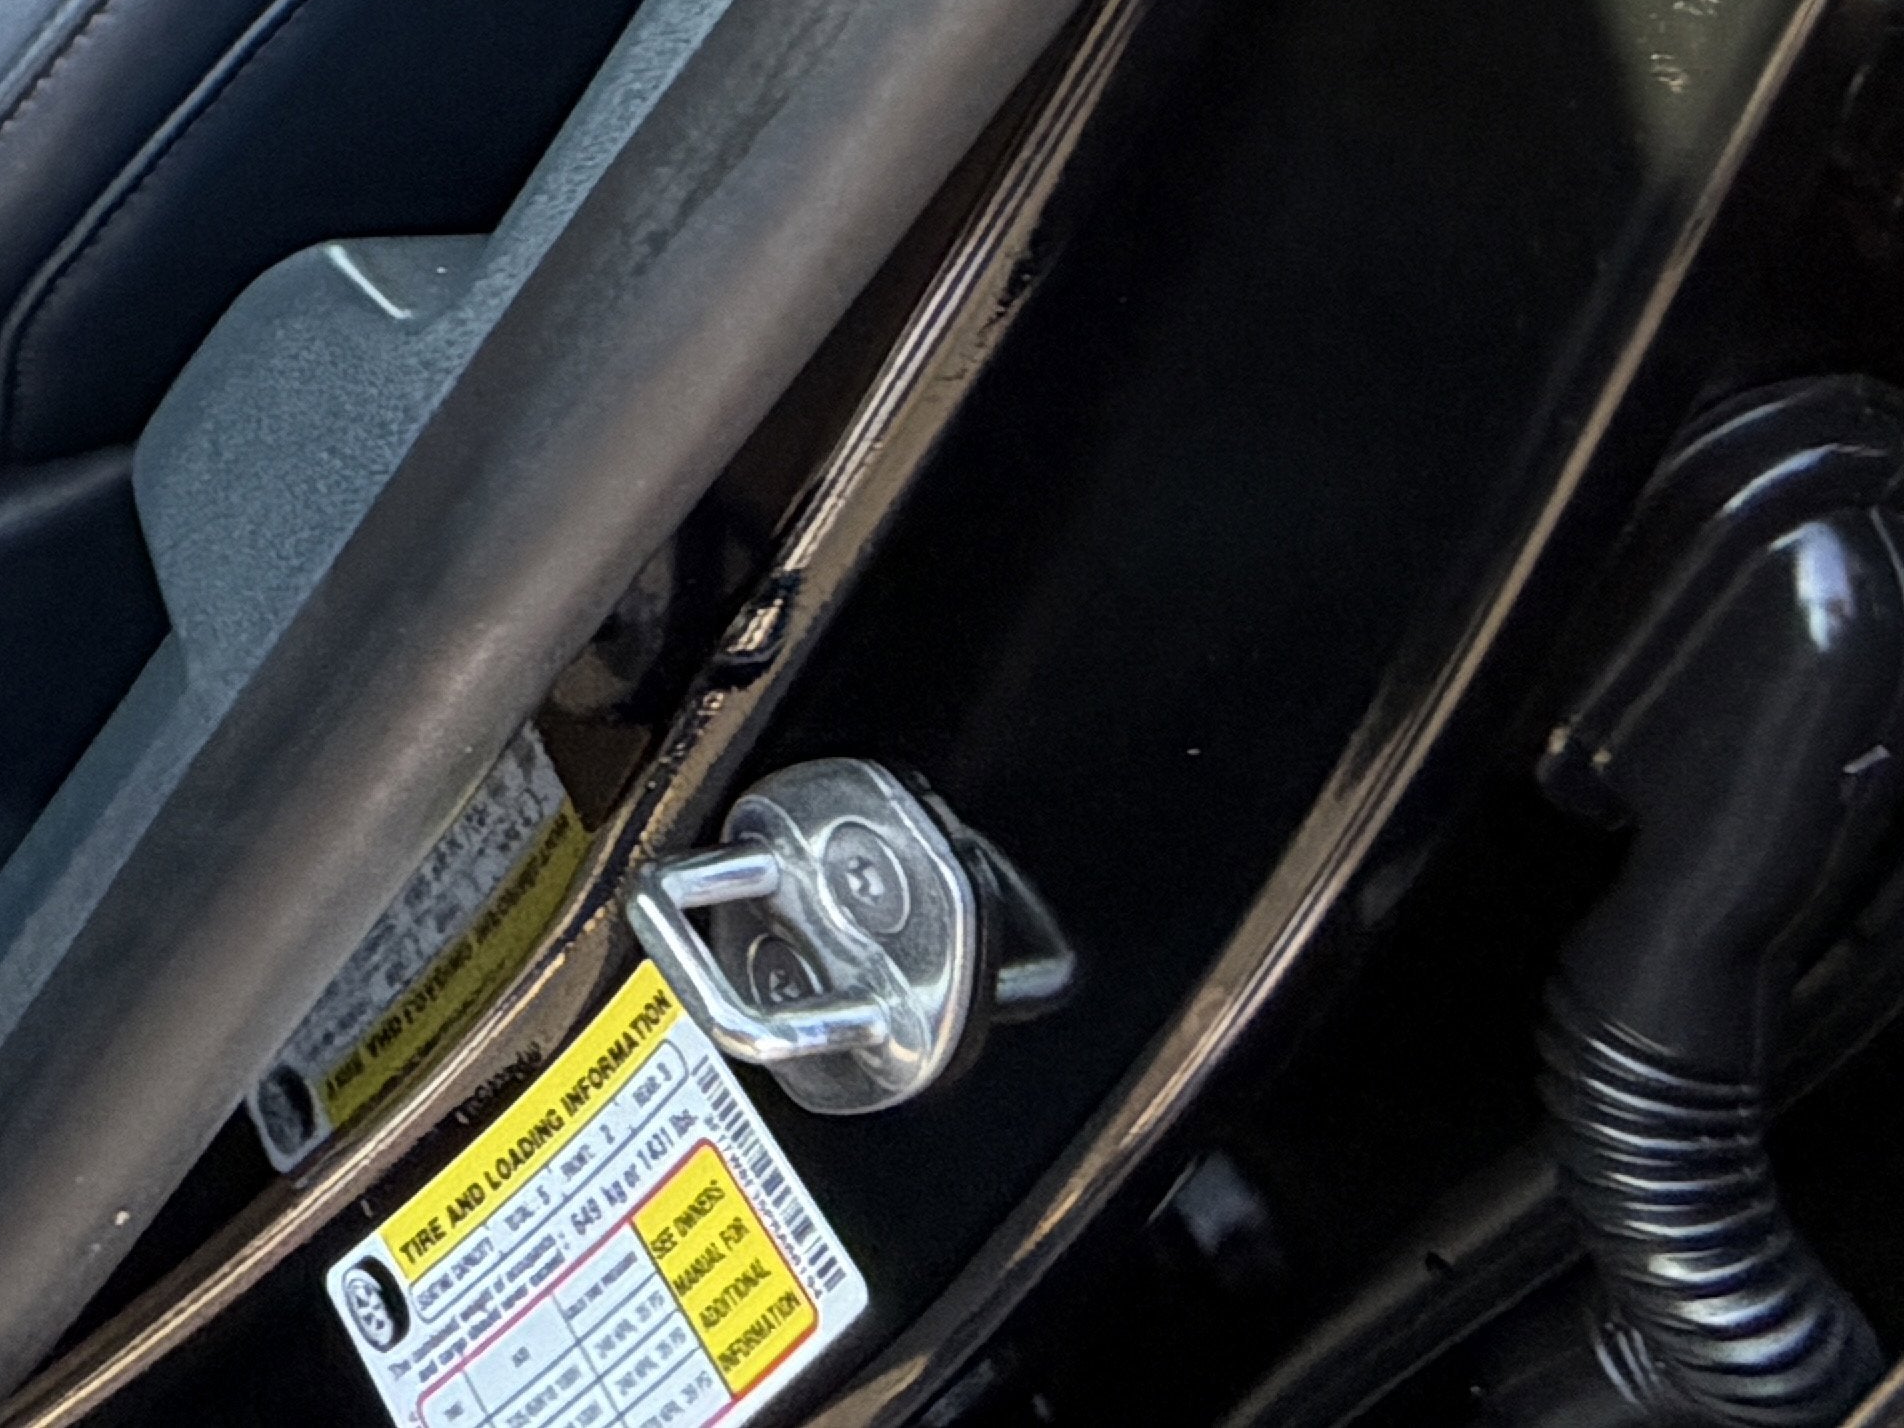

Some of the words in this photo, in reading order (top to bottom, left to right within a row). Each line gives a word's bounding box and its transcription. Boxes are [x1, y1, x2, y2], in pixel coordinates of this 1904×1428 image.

[399, 1217, 448, 1265] TIRE
[445, 1181, 487, 1225] AND
[484, 1109, 565, 1192] LOADING
[560, 989, 673, 1118] INFORMATION
[671, 1242, 727, 1297] MANUAL
[719, 1216, 752, 1255] FOR
[698, 1258, 773, 1329] ADDITIONAL
[715, 1289, 803, 1373] INFORMATION
